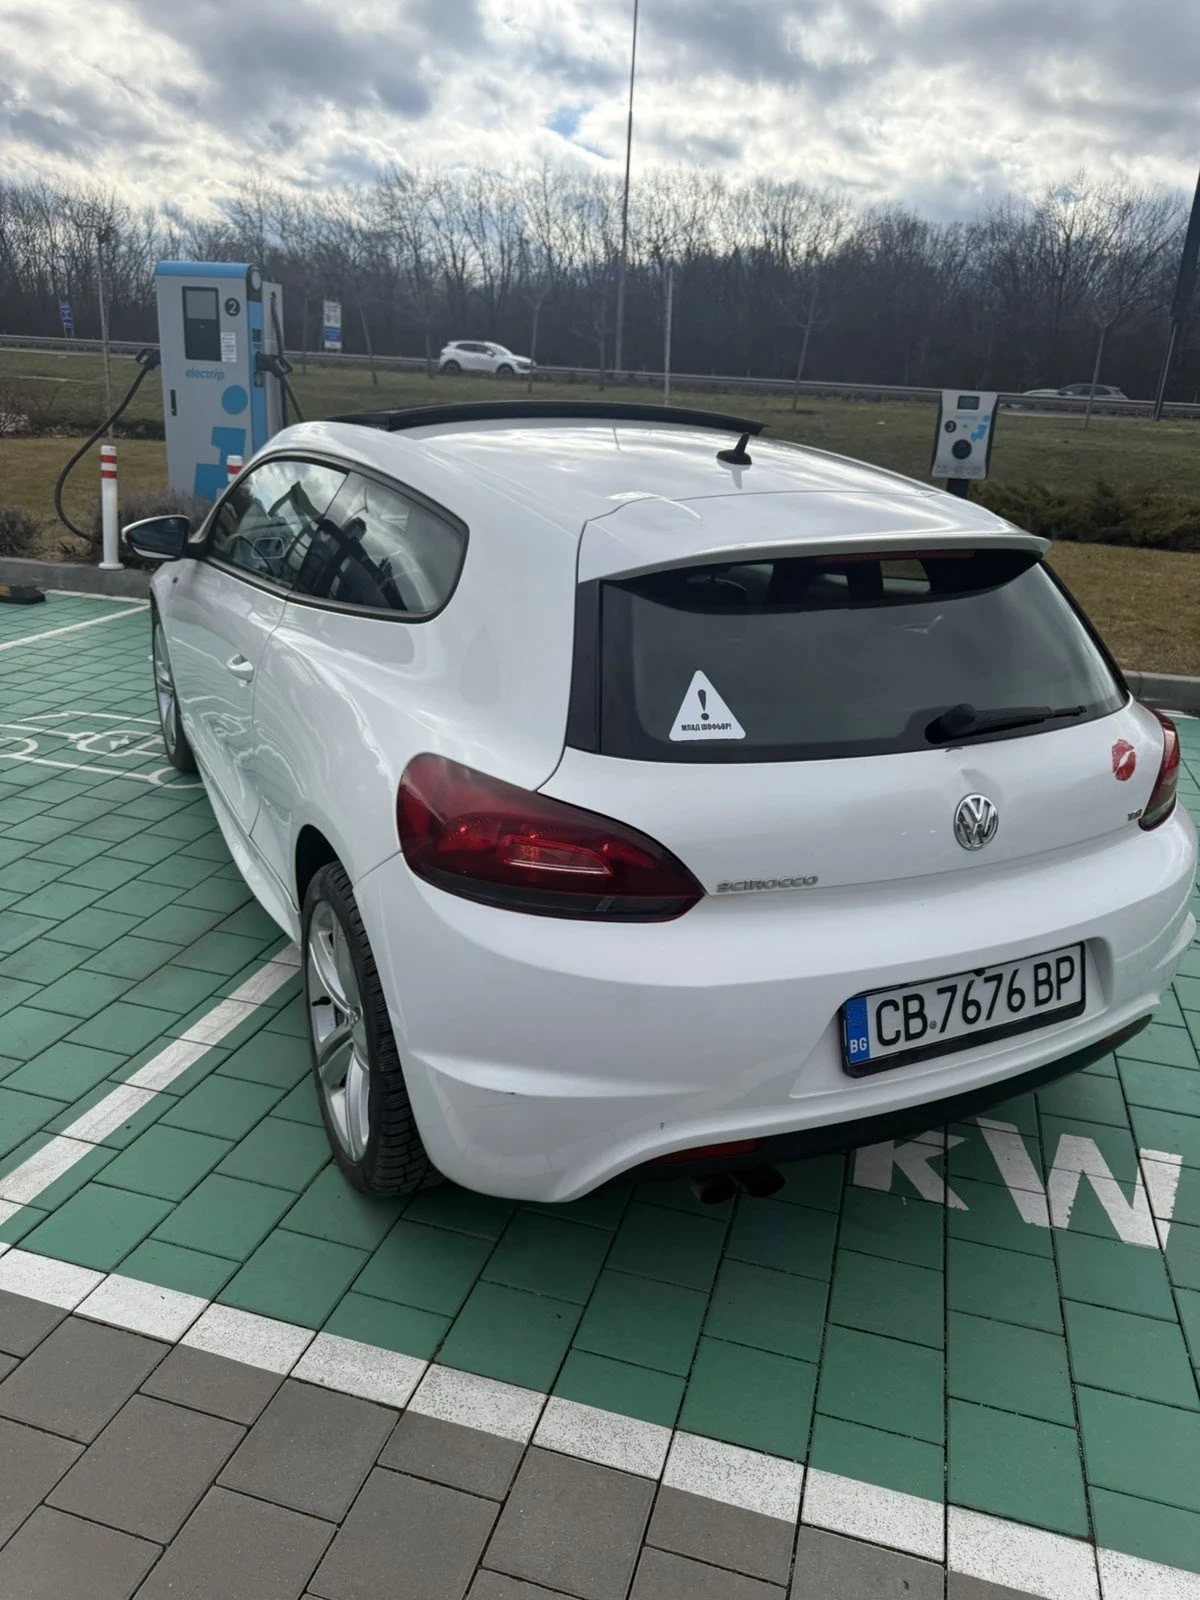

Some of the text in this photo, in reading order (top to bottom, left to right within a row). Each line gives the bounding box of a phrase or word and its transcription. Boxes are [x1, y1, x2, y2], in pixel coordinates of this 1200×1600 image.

[228, 301, 237, 314] 2
[681, 724, 700, 732] МЛАД
[954, 793, 998, 851] VW
[716, 874, 819, 893] SCIROCCO
[850, 955, 1075, 1054] BG CB 7676 BP
